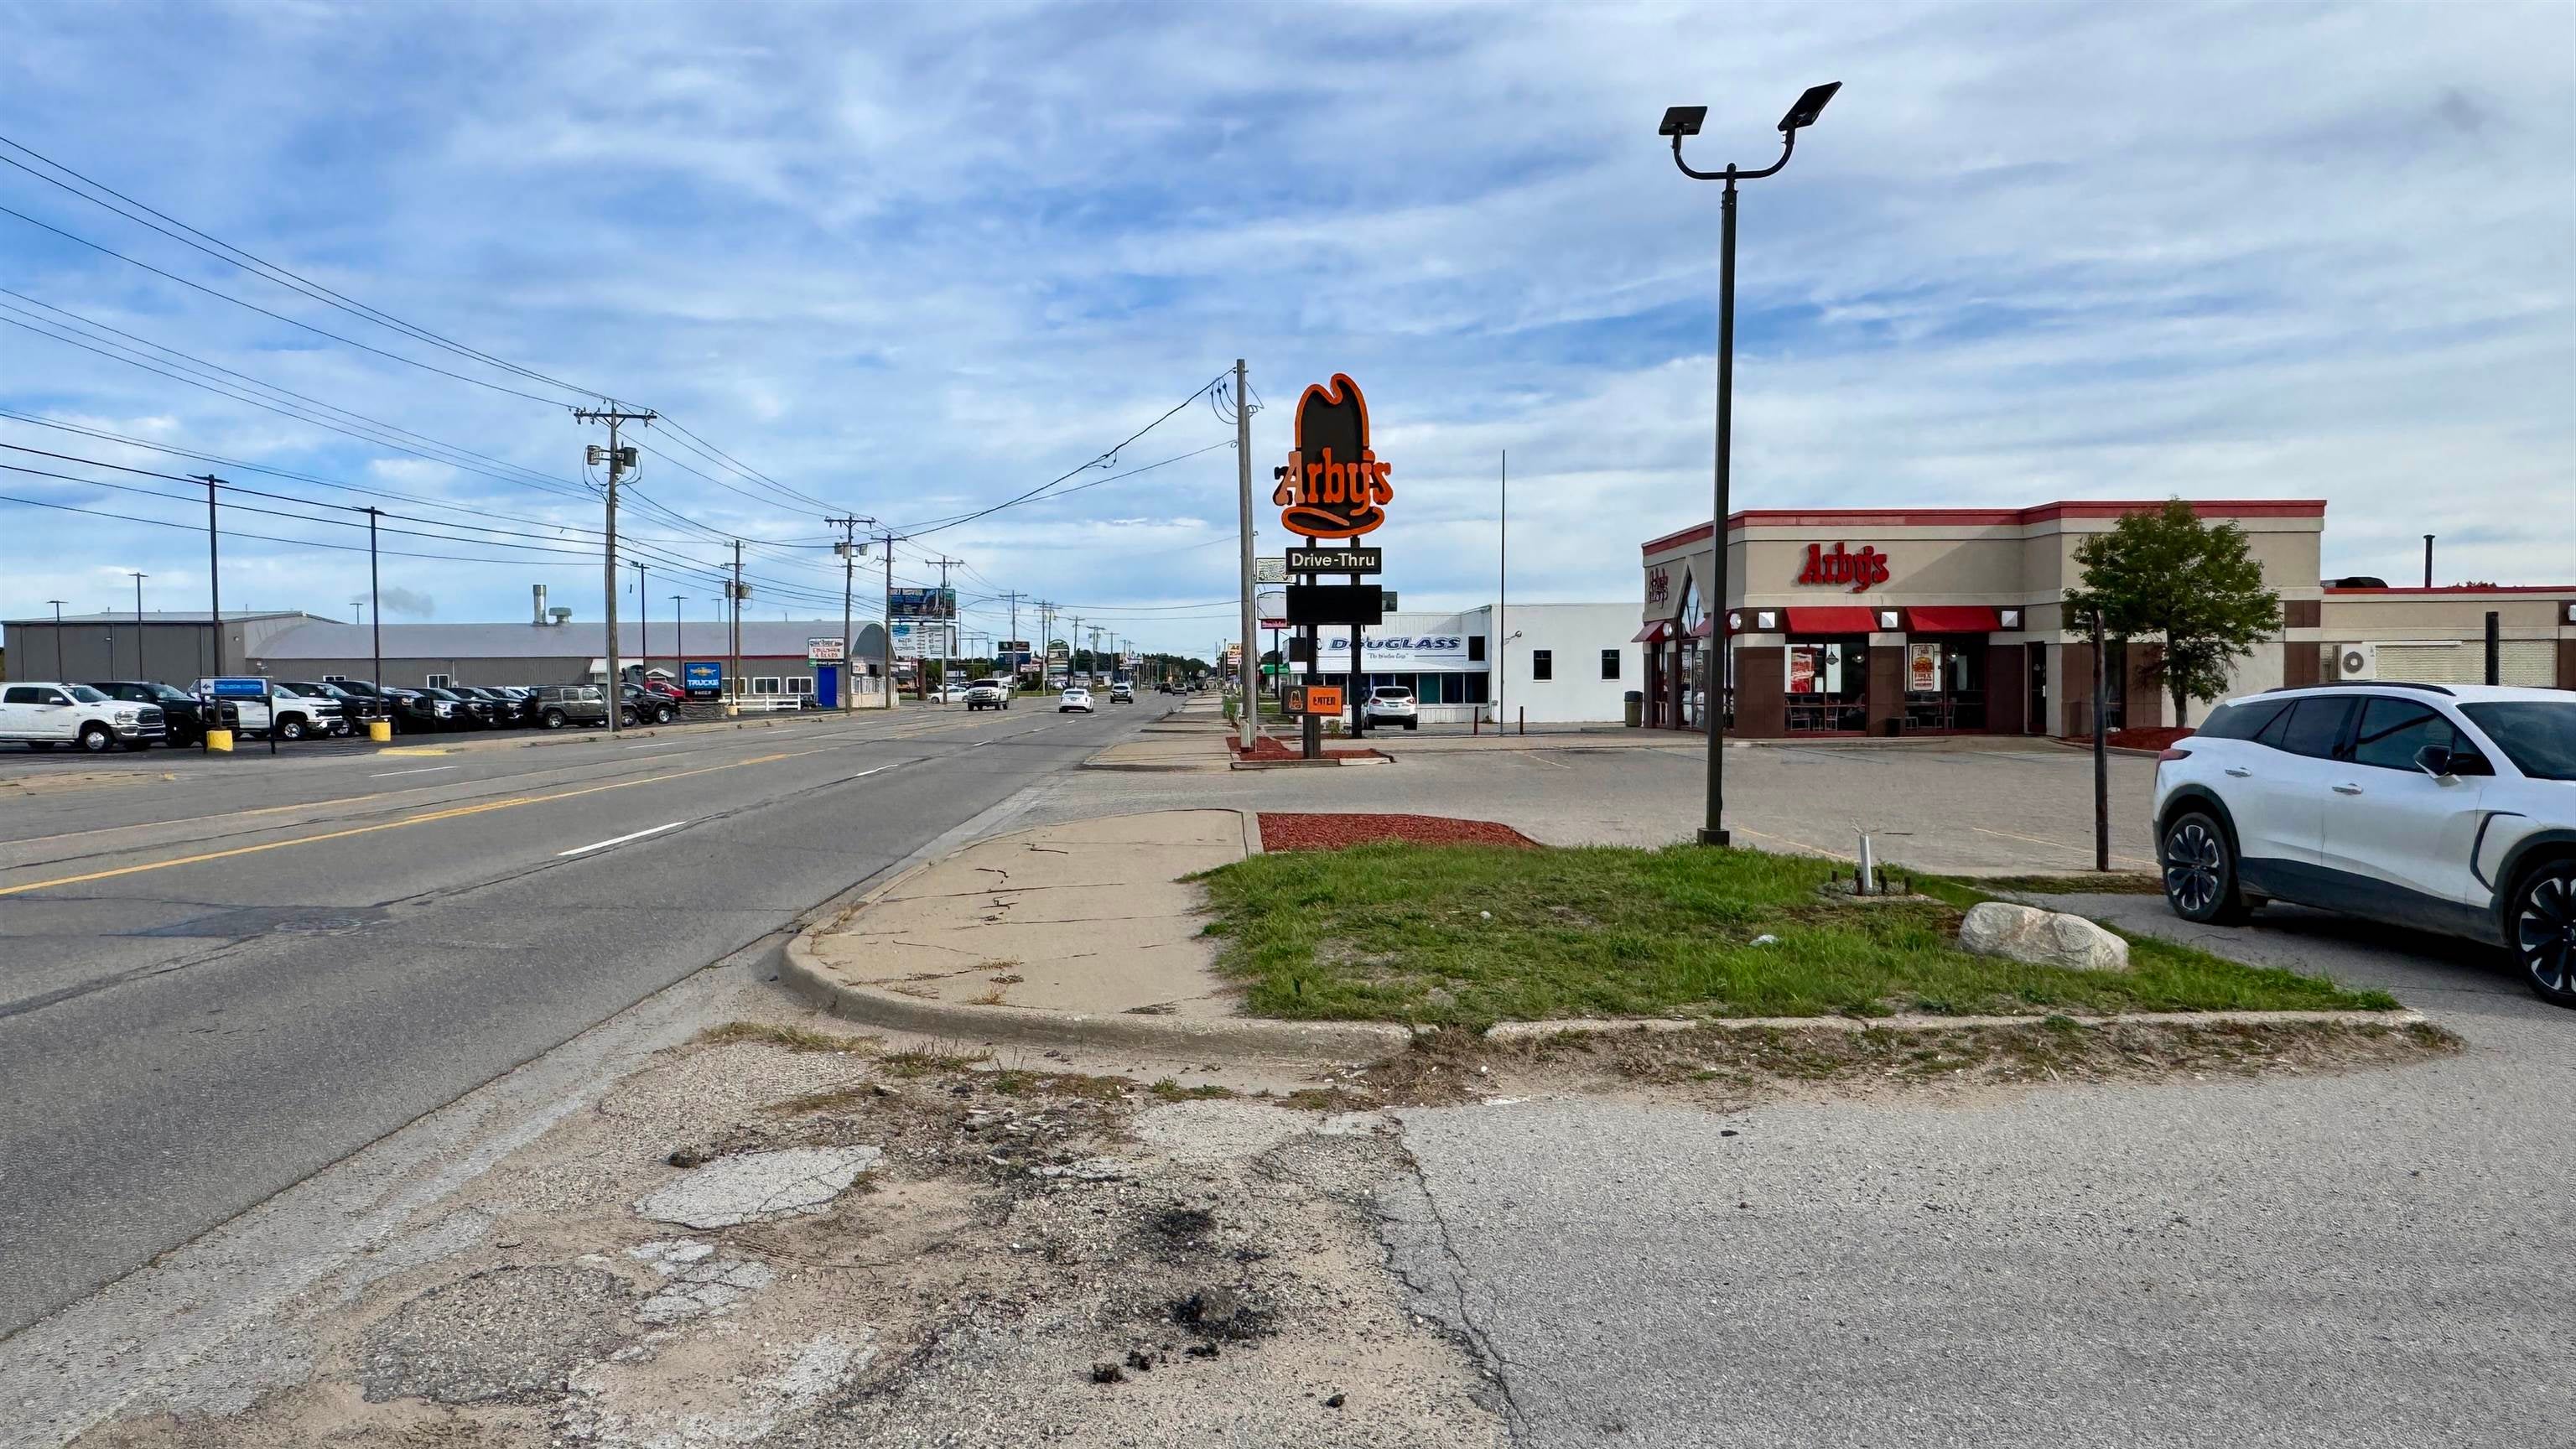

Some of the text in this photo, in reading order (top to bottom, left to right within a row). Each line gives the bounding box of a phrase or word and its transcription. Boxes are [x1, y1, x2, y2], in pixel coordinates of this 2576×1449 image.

[1273, 447, 1394, 516] Arby's
[1291, 553, 1375, 567] Drive-Thru
[1798, 542, 1889, 594] Arby's
